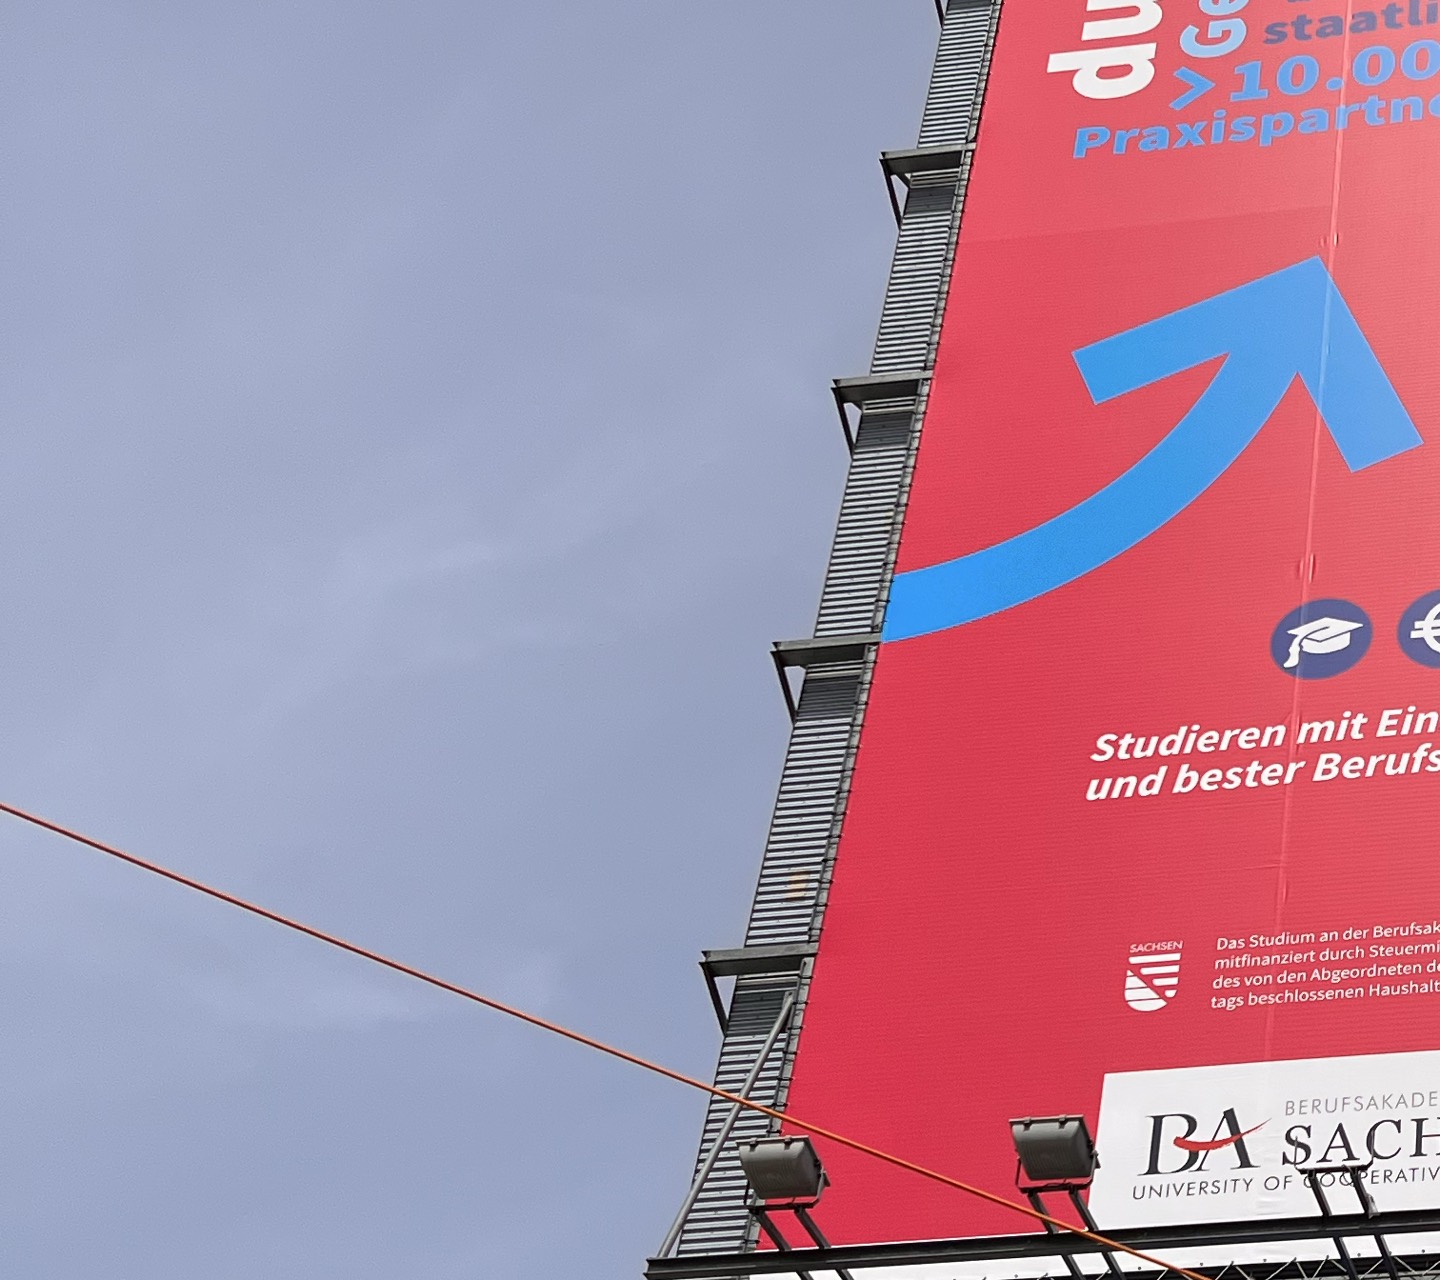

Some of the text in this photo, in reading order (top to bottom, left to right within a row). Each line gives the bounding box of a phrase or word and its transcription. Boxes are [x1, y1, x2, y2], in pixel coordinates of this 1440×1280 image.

[1090, 720, 1286, 763] Studieren
[1296, 710, 1369, 746] mit
[1085, 766, 1168, 801] und
[1171, 756, 1307, 794] bester
[1129, 940, 1184, 953] SACHSEN
[1216, 936, 1246, 951] Das
[1249, 930, 1315, 949] Studium
[1319, 930, 1339, 943] an
[1342, 925, 1369, 941] der
[1214, 949, 1316, 971] mitfinanziert
[1319, 944, 1365, 962] durch
[1212, 974, 1240, 989] des
[1244, 973, 1273, 986] von
[1276, 968, 1306, 984] den
[1310, 959, 1422, 984] Abgeordneten
[1211, 995, 1244, 1011] tags
[1248, 984, 1365, 1007] beschlossenen
[1137, 1107, 1261, 1177] BA
[1132, 1173, 1253, 1201] UNIVERSITY
[1264, 1172, 1293, 1192] OF
